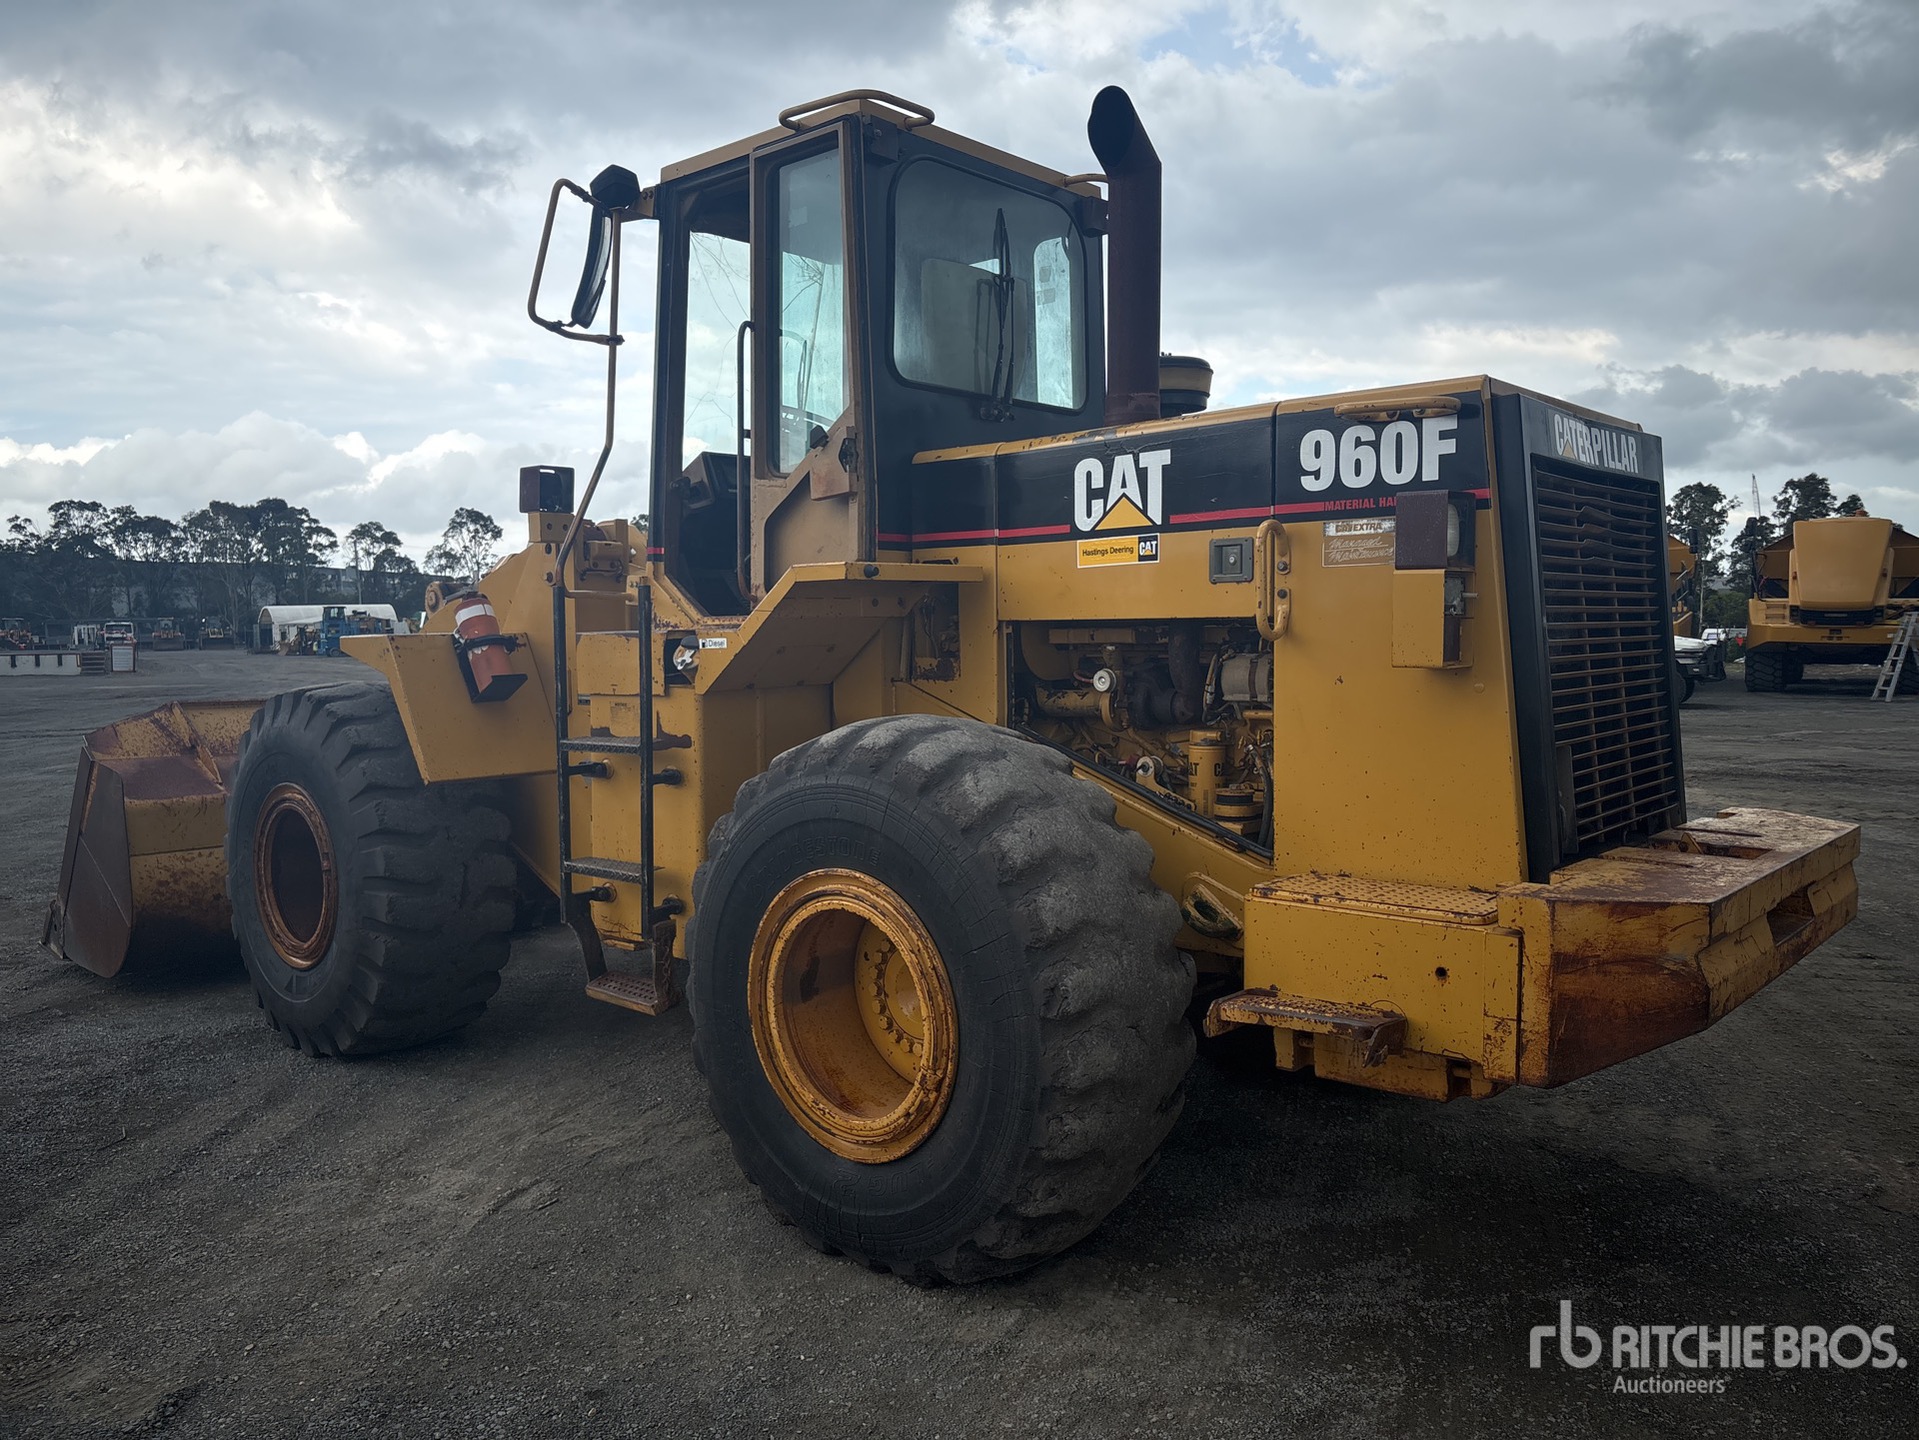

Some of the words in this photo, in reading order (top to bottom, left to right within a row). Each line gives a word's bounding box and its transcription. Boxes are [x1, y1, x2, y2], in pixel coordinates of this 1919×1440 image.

[1554, 414, 1638, 473] CATERPILLAR
[1300, 414, 1458, 491] 960F
[1074, 449, 1171, 532] CAT
[1325, 498, 1376, 511] MATERIAL
[1082, 548, 1109, 557] Hastings
[1110, 546, 1134, 555] Deering
[1139, 541, 1157, 556] CAT
[708, 639, 725, 647] Diesel
